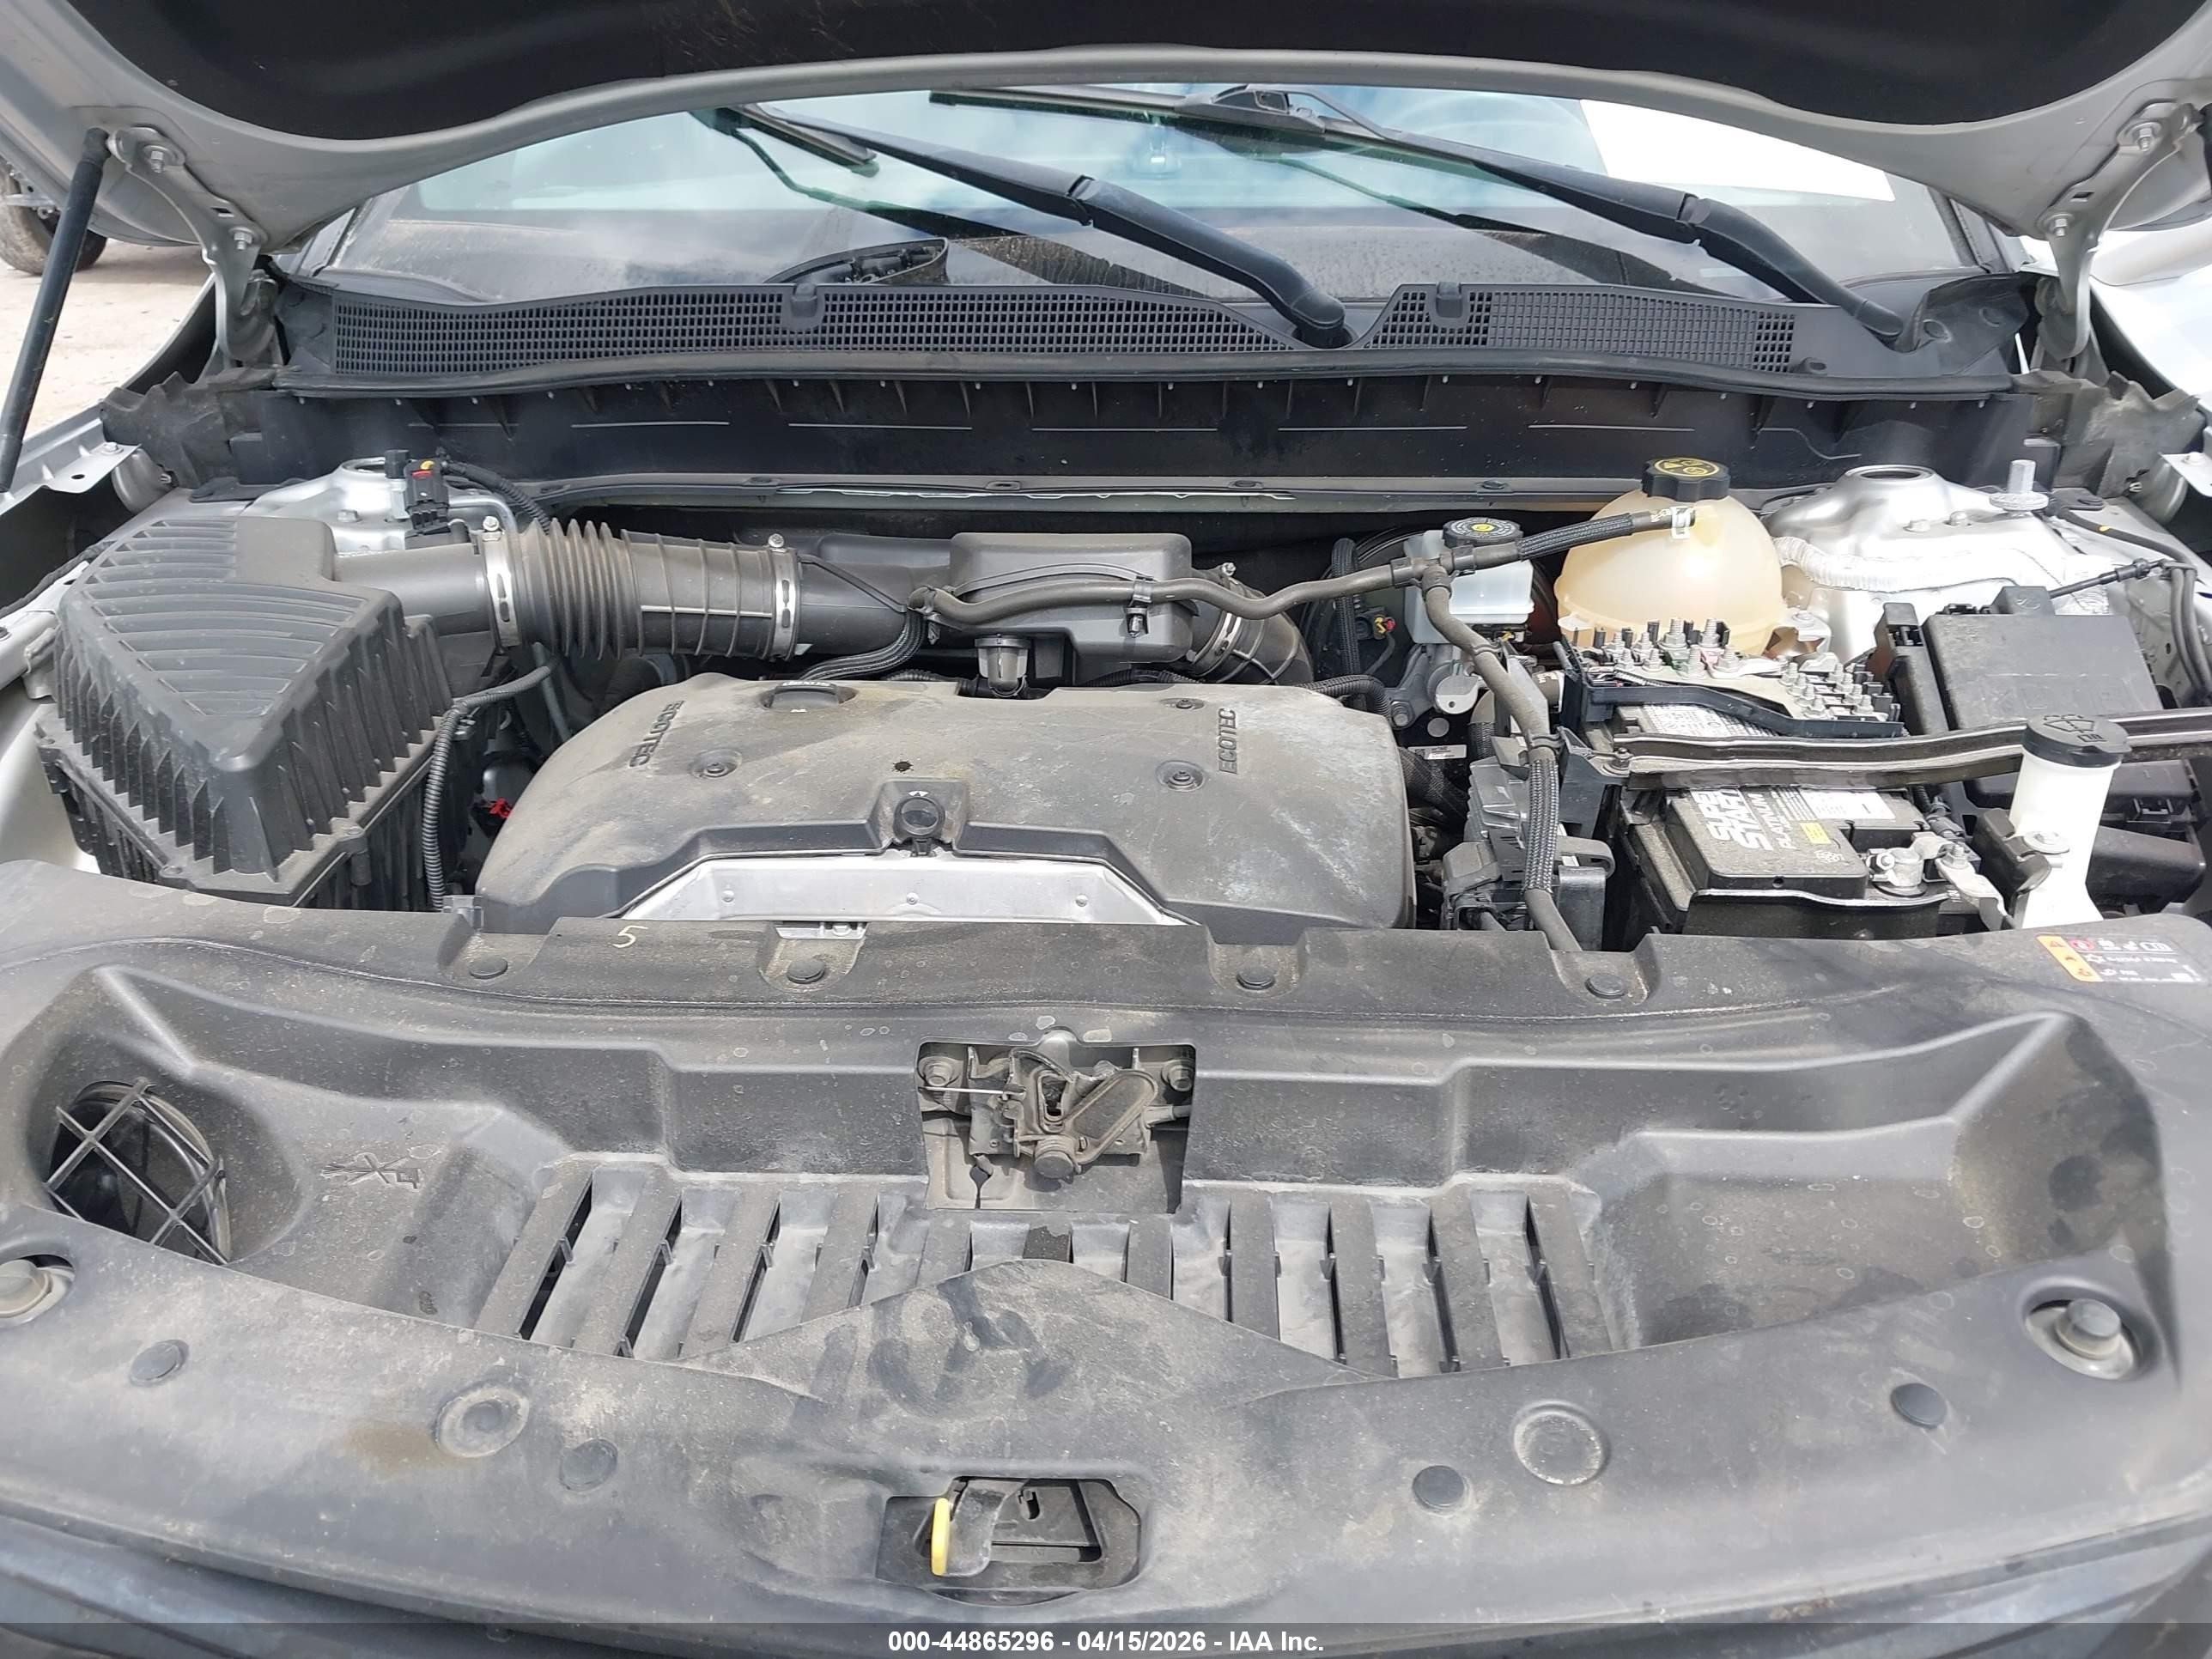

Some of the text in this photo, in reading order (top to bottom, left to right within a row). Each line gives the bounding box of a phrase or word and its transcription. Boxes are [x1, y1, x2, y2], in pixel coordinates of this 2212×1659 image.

[629, 700, 685, 768] ECOTEC
[1218, 708, 1237, 774] ECOTEC
[1690, 790, 1734, 841] SUPE
[1747, 793, 1797, 850] PLATINUM
[612, 925, 648, 948] 5
